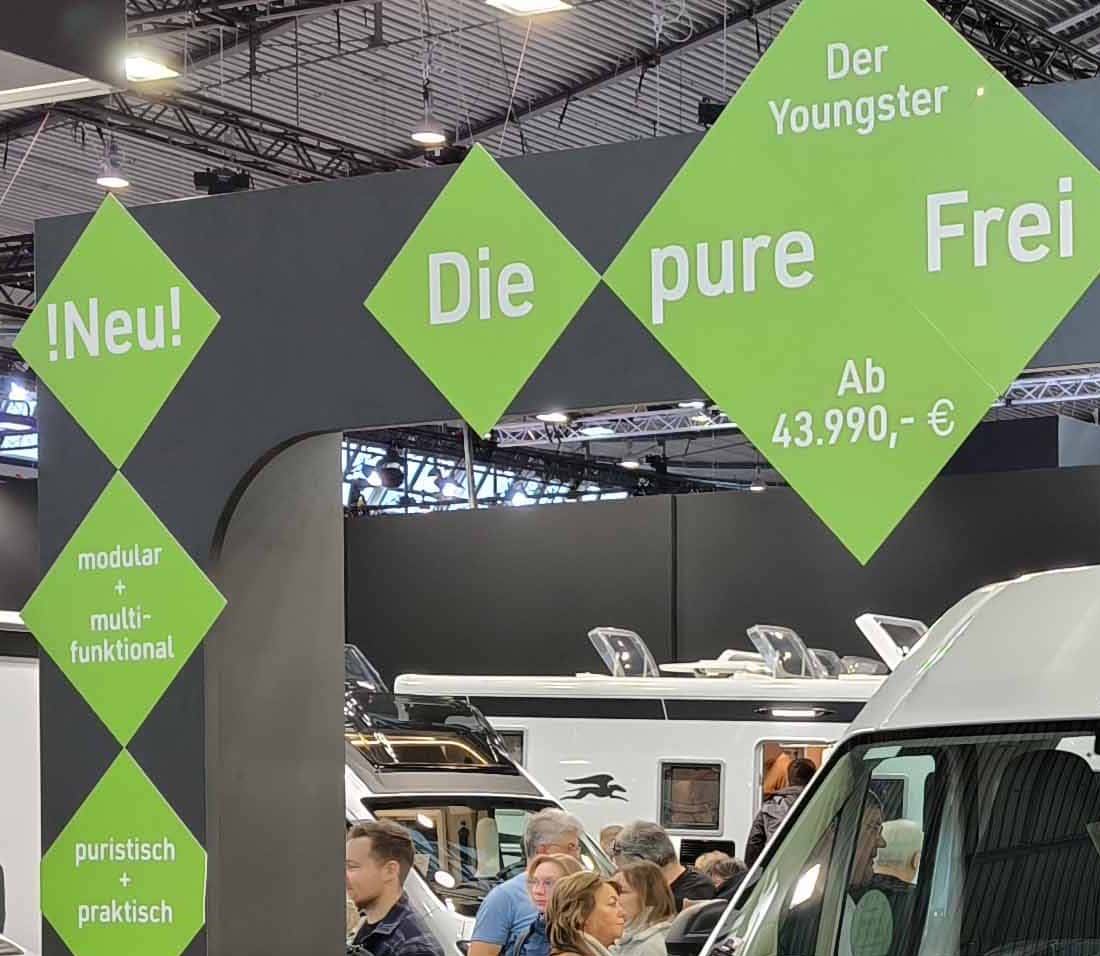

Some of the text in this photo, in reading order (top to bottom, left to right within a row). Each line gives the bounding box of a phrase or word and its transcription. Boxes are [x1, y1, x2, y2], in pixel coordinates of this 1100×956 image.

[827, 42, 889, 80] Der
[768, 78, 949, 136] Youngster
[427, 246, 536, 326] Die
[650, 230, 816, 326] pure
[925, 175, 1075, 273] Frei
[46, 286, 182, 363] !Neu!
[837, 358, 886, 396] Ab
[771, 397, 955, 450] 43.990,- €
[77, 544, 163, 571] modular
[114, 581, 126, 594] +
[89, 605, 153, 632] multi-
[69, 635, 175, 664] funktional
[74, 837, 176, 866] puristisch
[119, 873, 131, 887] +
[77, 899, 174, 929] praktisch
